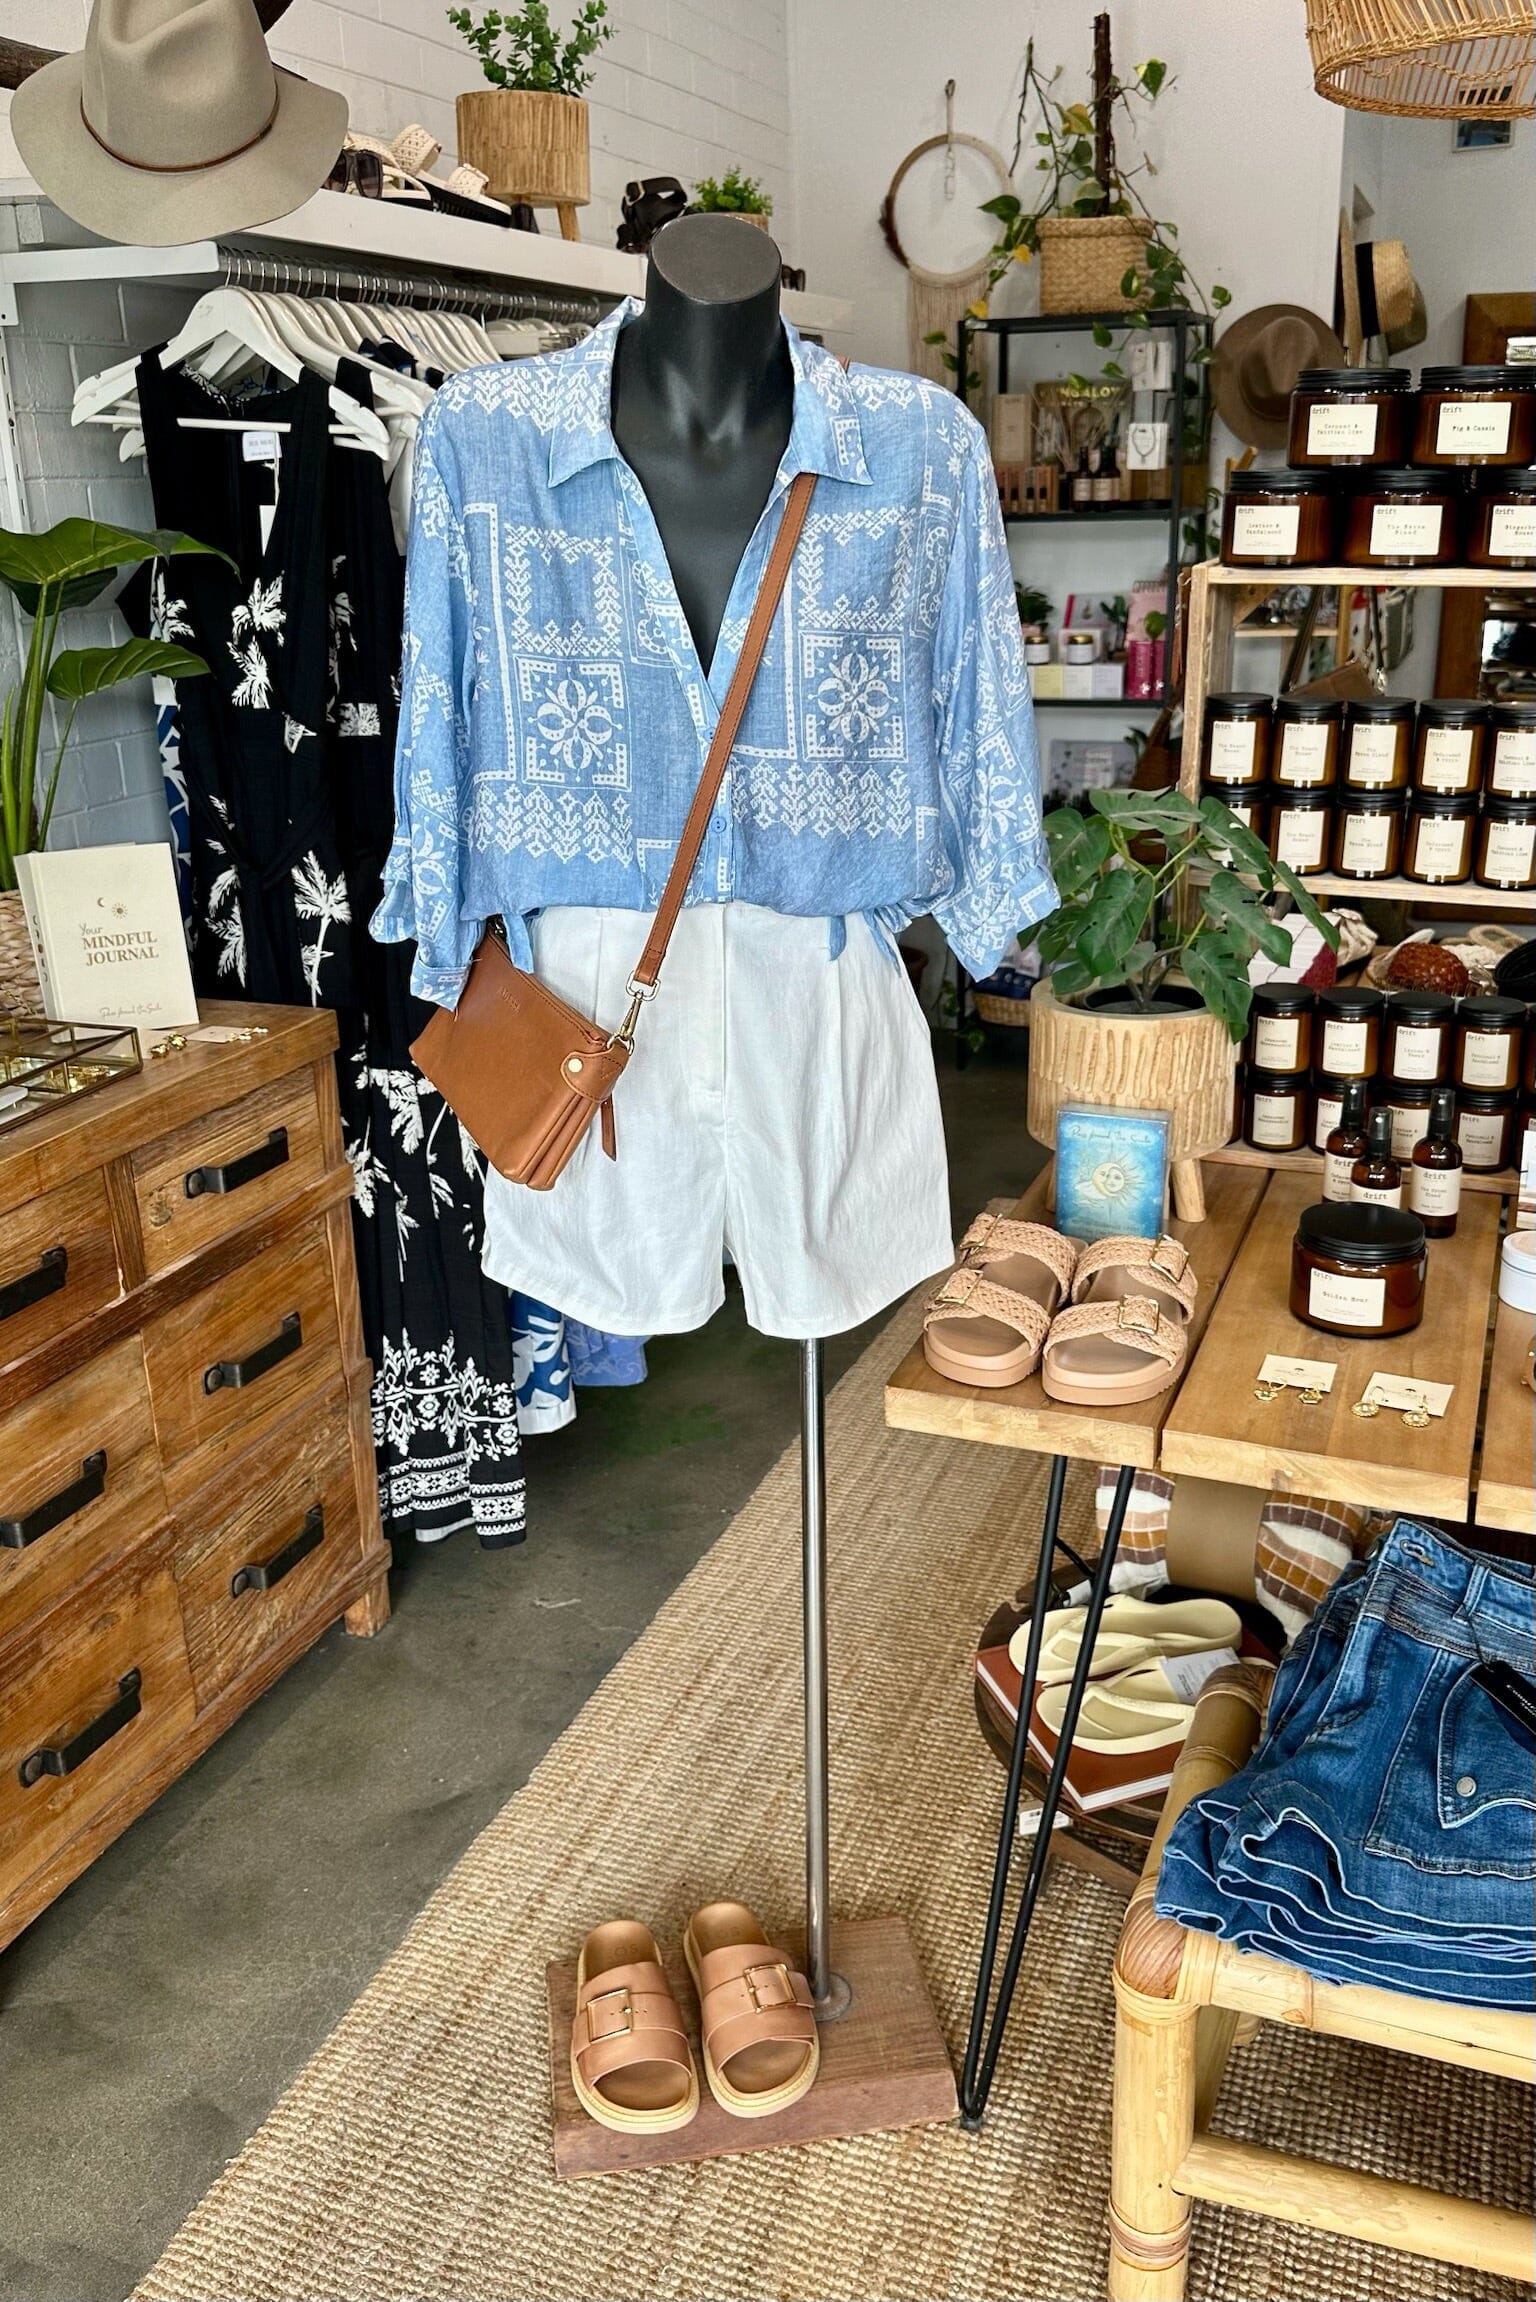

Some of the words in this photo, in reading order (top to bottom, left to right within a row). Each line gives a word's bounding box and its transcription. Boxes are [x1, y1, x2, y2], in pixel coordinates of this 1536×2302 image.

[1312, 407, 1330, 415] drift
[1377, 507, 1397, 515] drift
[79, 923, 103, 936] Your
[82, 931, 158, 950] MINDFUL
[86, 946, 159, 967] JOURNAL
[1334, 1159, 1353, 1167] drif
[1423, 1171, 1447, 1180] drift
[1363, 1192, 1388, 1200] drift
[1313, 1271, 1332, 1280] drift
